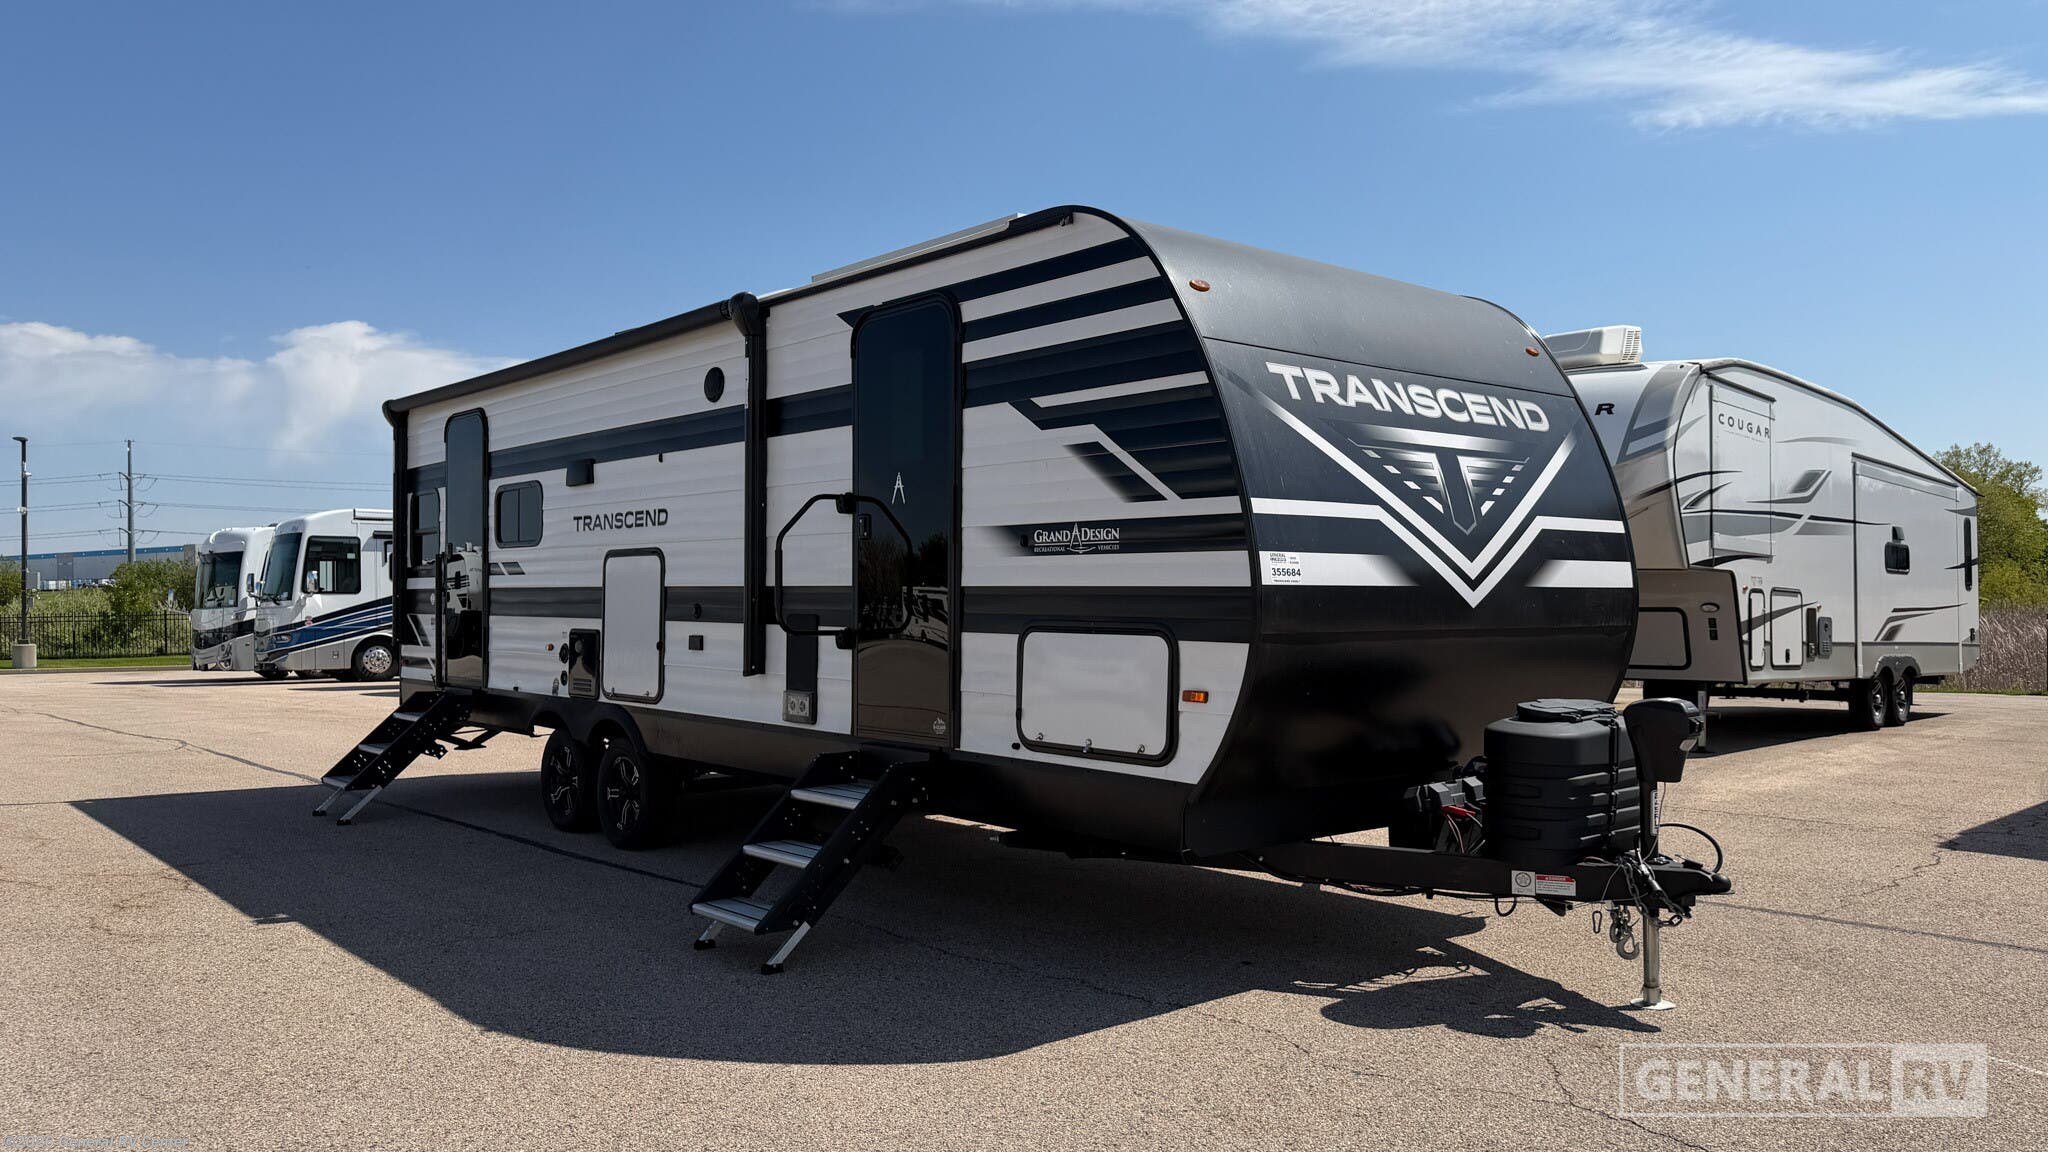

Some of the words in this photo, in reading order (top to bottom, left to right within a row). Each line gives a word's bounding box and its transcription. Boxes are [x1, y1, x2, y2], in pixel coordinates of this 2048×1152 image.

[1265, 361, 1550, 432] TRANSCEND
[1718, 413, 1770, 439] COUGAR
[573, 508, 669, 532] TRANSCEND
[1034, 529, 1071, 543] GRAND
[1081, 527, 1120, 541] DESIGN
[1271, 567, 1301, 577] 355684
